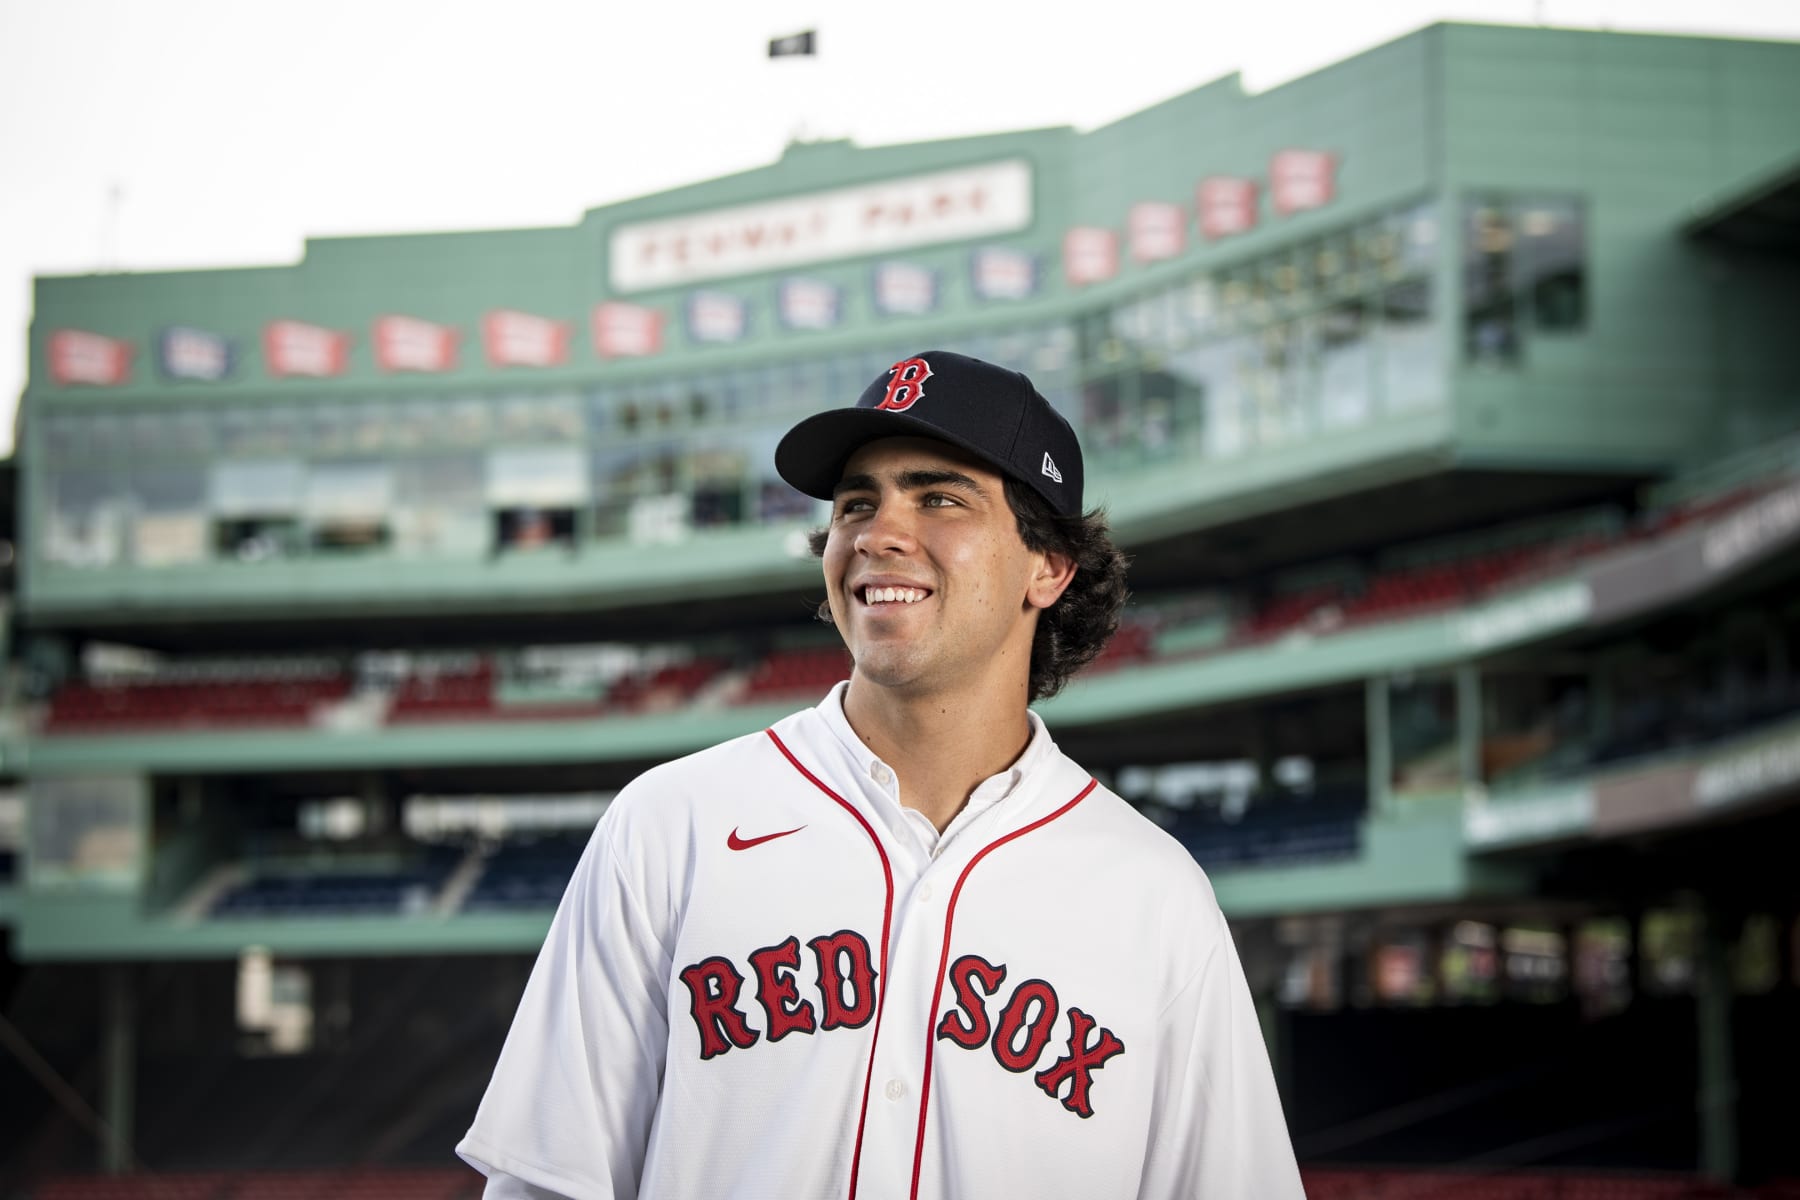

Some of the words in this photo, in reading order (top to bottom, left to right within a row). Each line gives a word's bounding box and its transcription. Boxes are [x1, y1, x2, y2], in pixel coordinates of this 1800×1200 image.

[874, 358, 934, 412] B
[679, 929, 879, 1060] RED
[937, 955, 1125, 1119] SOX
